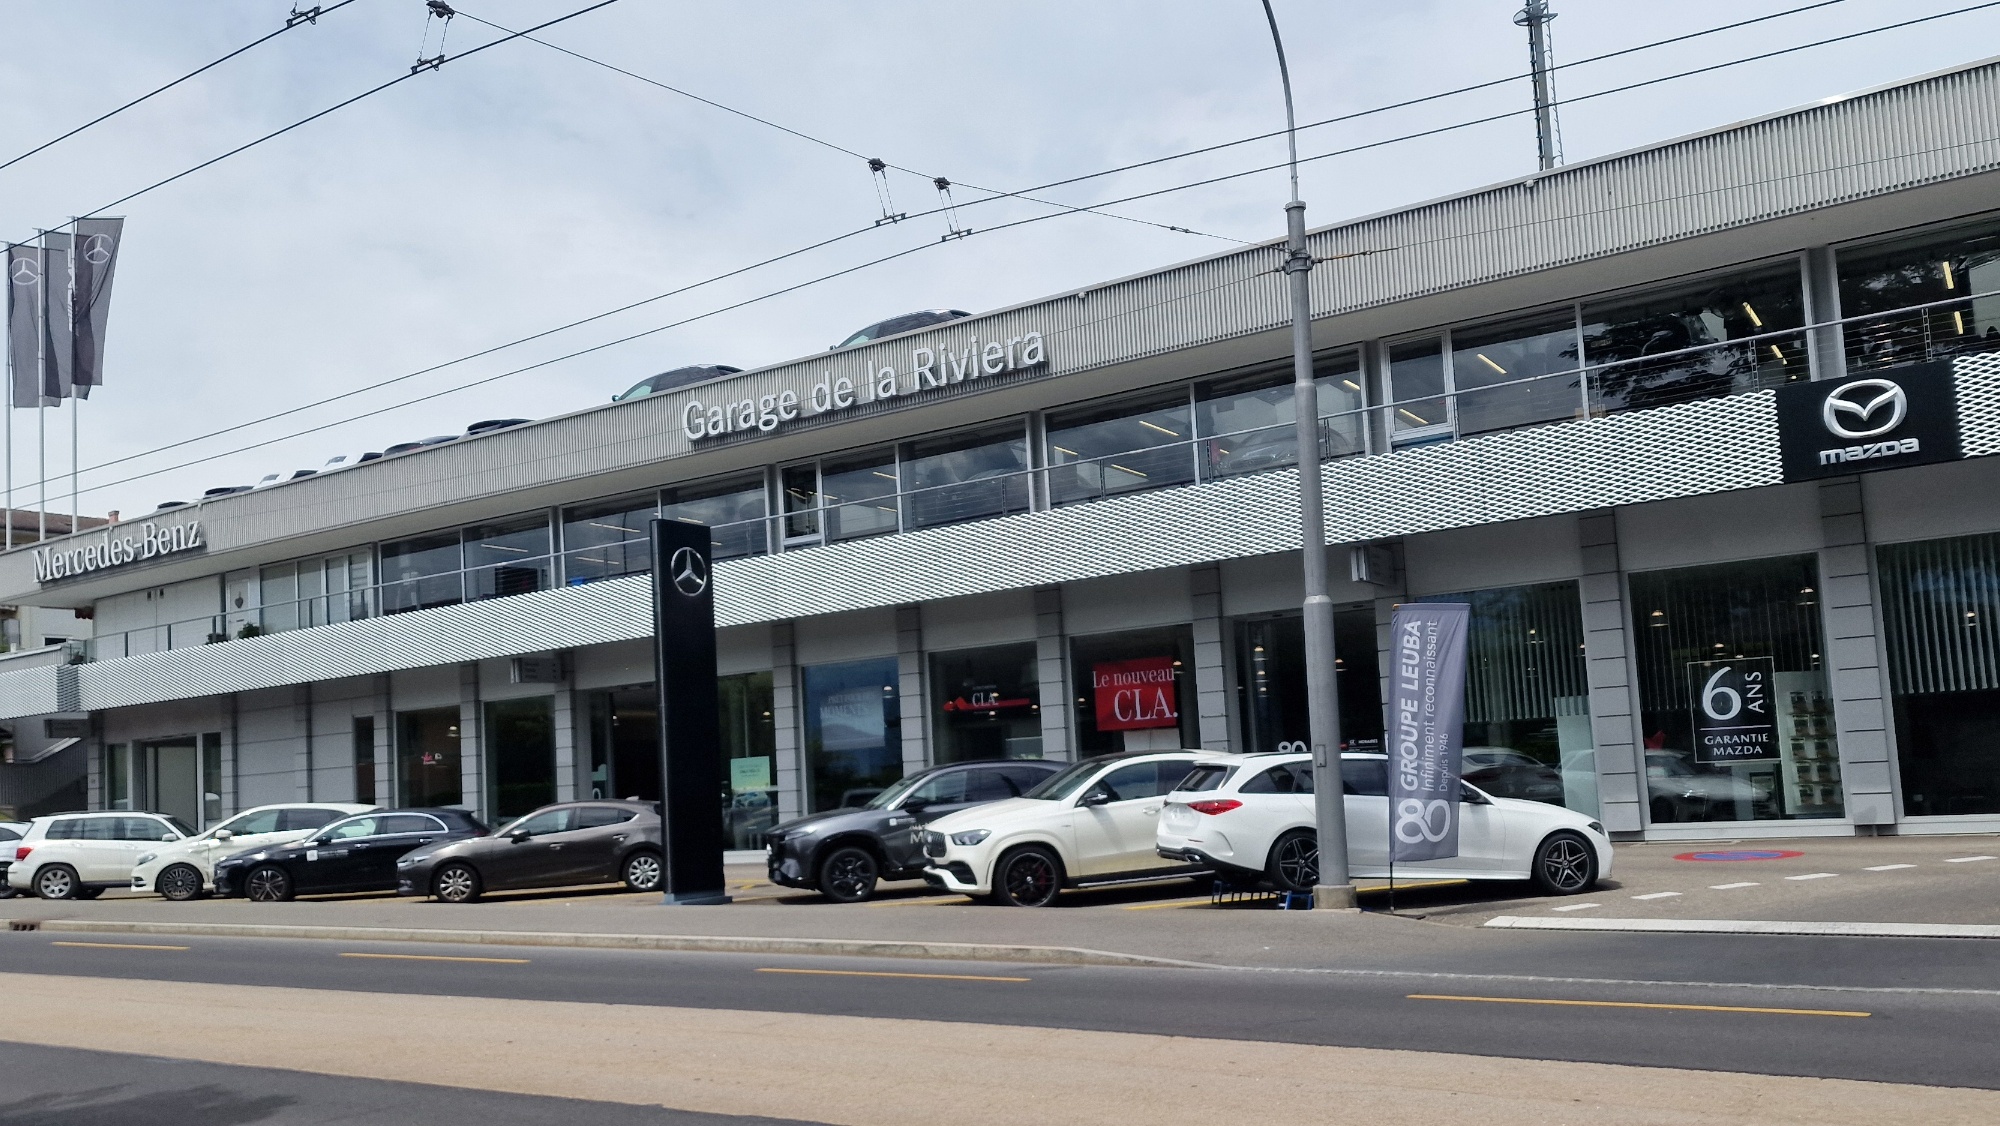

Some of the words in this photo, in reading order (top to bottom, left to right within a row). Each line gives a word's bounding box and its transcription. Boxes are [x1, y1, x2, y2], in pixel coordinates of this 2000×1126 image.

[683, 390, 799, 440] Garage
[812, 371, 854, 412] de
[868, 360, 897, 400] la
[913, 332, 1045, 390] Riviera
[32, 521, 200, 583] Mercedes-Benz
[1092, 670, 1110, 689] Le
[1113, 668, 1175, 686] nouveau
[1401, 620, 1421, 691] LEUBA
[1423, 620, 1438, 717] reconnaissant
[1114, 686, 1179, 722] CLA.
[1702, 666, 1742, 720] 6
[1745, 671, 1765, 713] ANS
[1400, 698, 1419, 791] GROUPE
[1421, 720, 1435, 792] Infiniment
[1439, 733, 1449, 756] 1946
[1704, 733, 1769, 745] GARANTIE
[1713, 745, 1763, 756] MAZDA
[1438, 759, 1449, 792] Depuis
